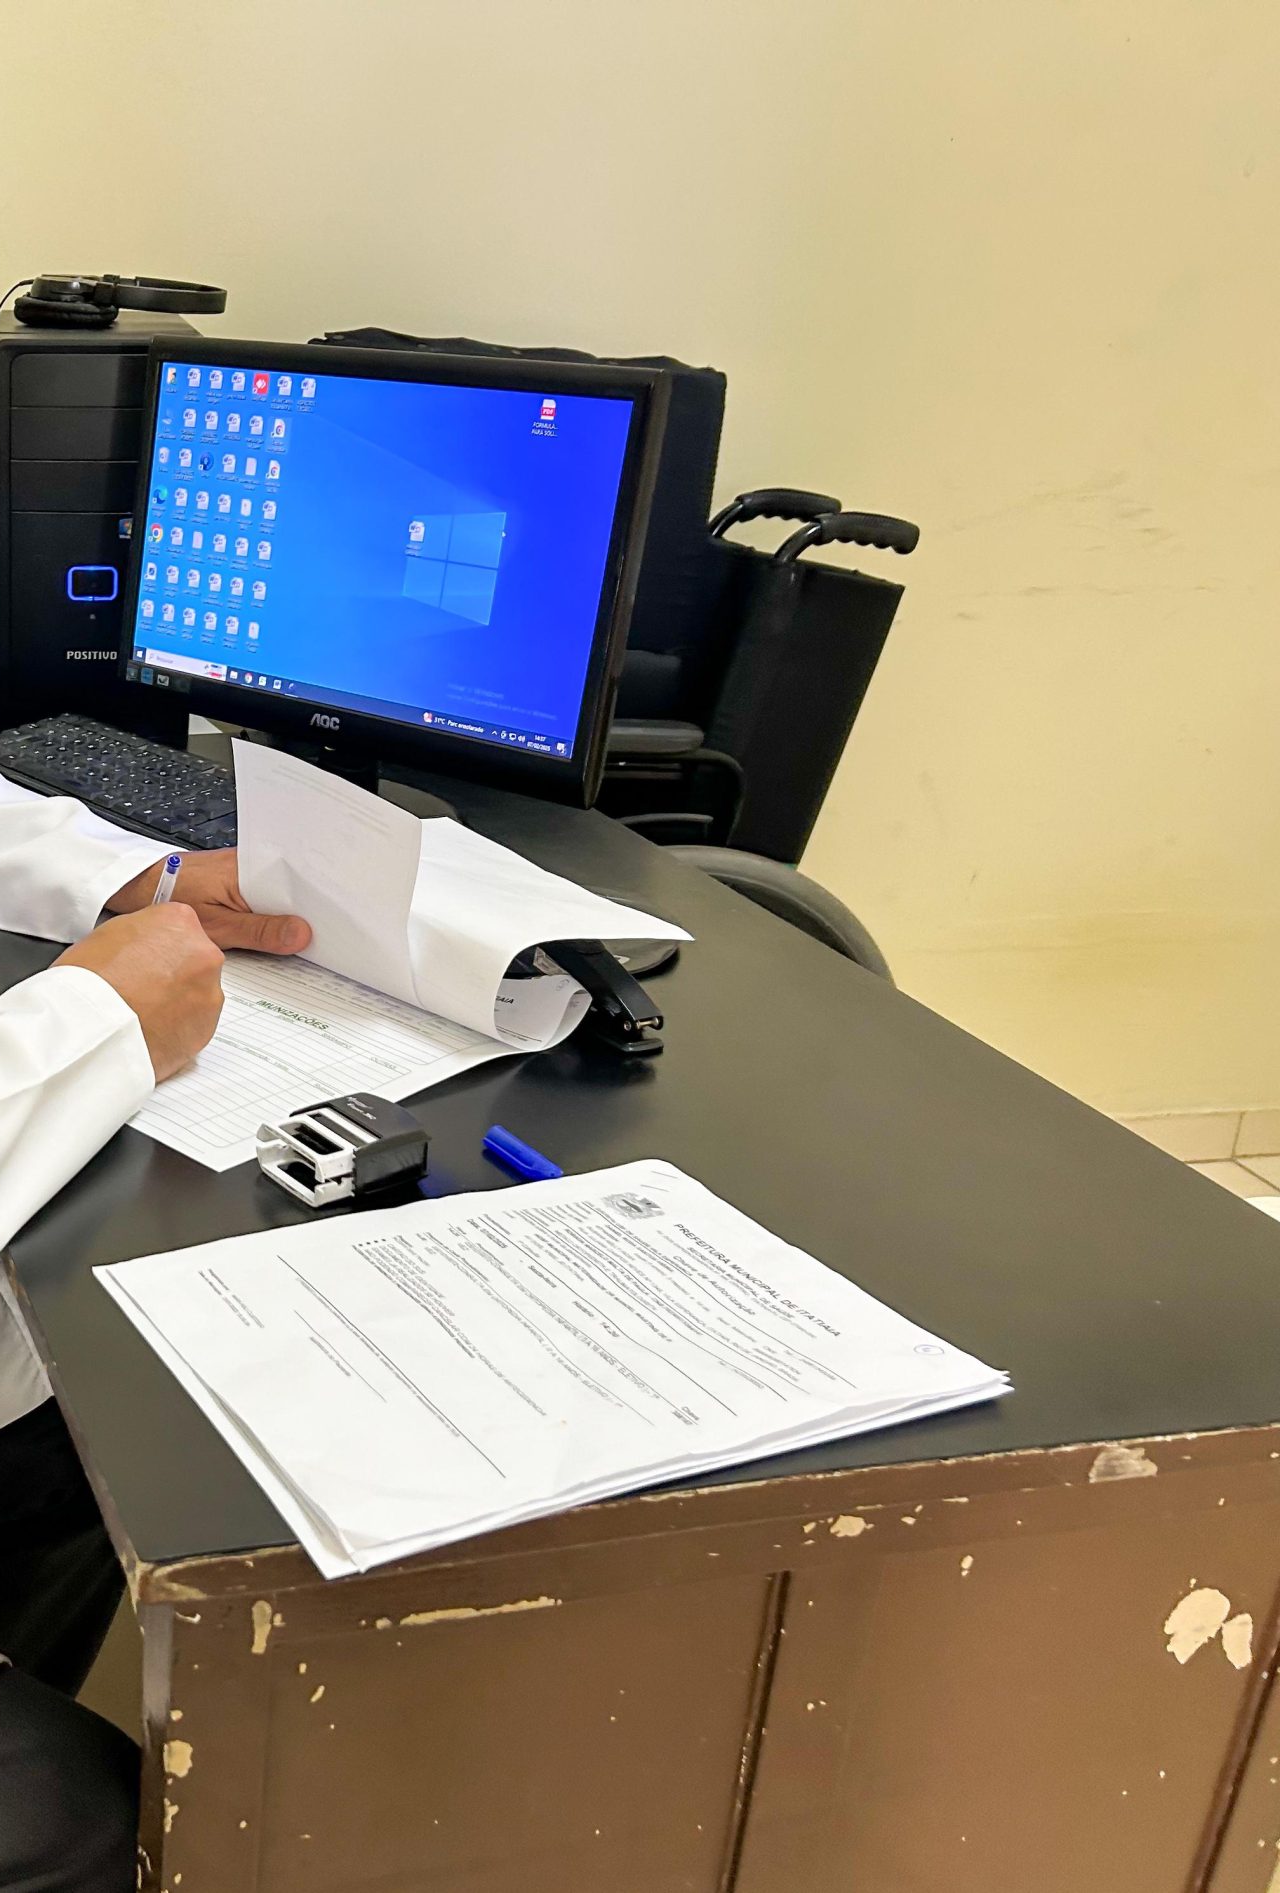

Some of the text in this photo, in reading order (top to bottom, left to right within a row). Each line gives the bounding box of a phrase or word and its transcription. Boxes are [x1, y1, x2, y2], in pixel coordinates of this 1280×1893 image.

[66, 651, 118, 660] POSITIVO
[310, 714, 340, 731] AOC
[255, 999, 329, 1031] IMUNIZAÇÕES
[669, 1223, 736, 1263] PREFEITURA
[726, 1263, 785, 1298] MUNICIPAL
[779, 1299, 799, 1309] DE
[794, 1307, 843, 1337] ITATIAIA
[670, 1255, 761, 1316] Chave de Autorização
